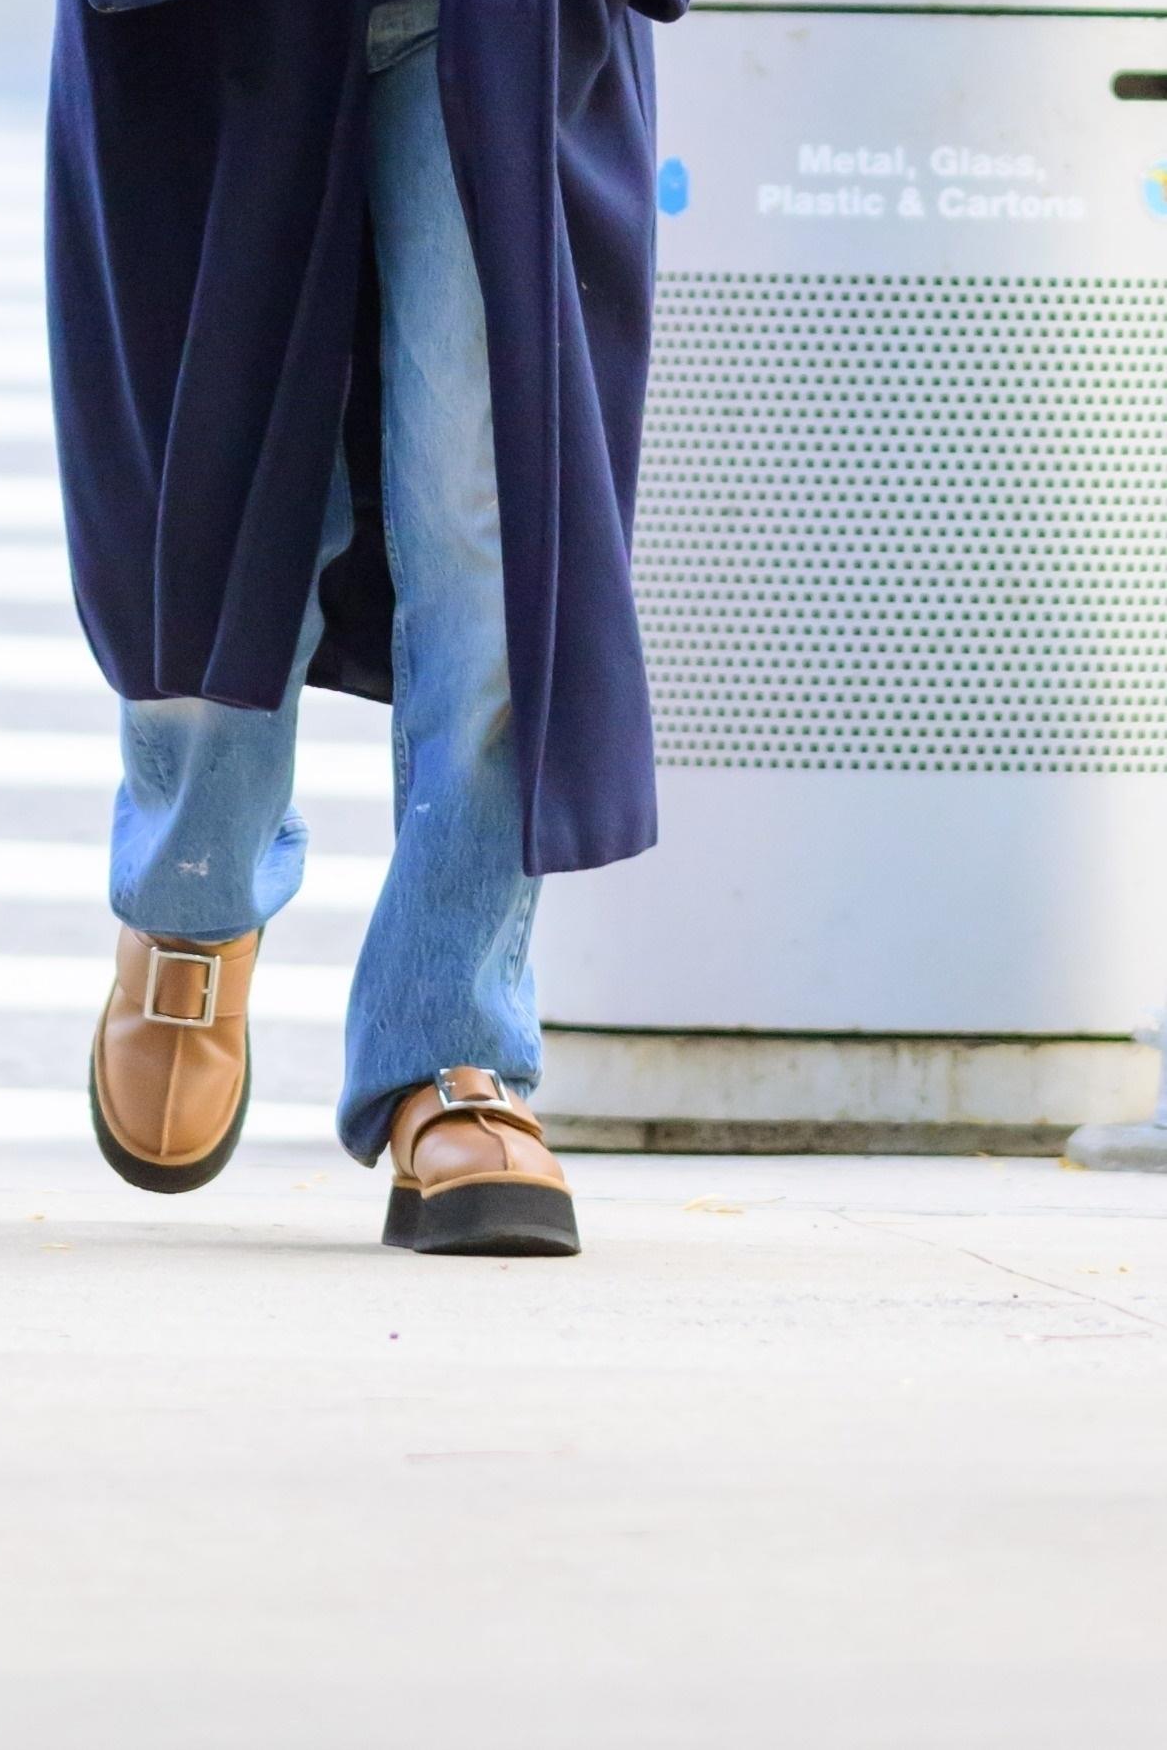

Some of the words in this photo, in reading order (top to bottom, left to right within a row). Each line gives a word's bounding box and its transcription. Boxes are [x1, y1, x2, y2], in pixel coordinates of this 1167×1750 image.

[798, 143, 915, 180] Metal,
[931, 145, 1047, 182] Glass,
[758, 184, 885, 217] Plastic
[896, 186, 925, 218] &
[937, 186, 1087, 219] Cartons
